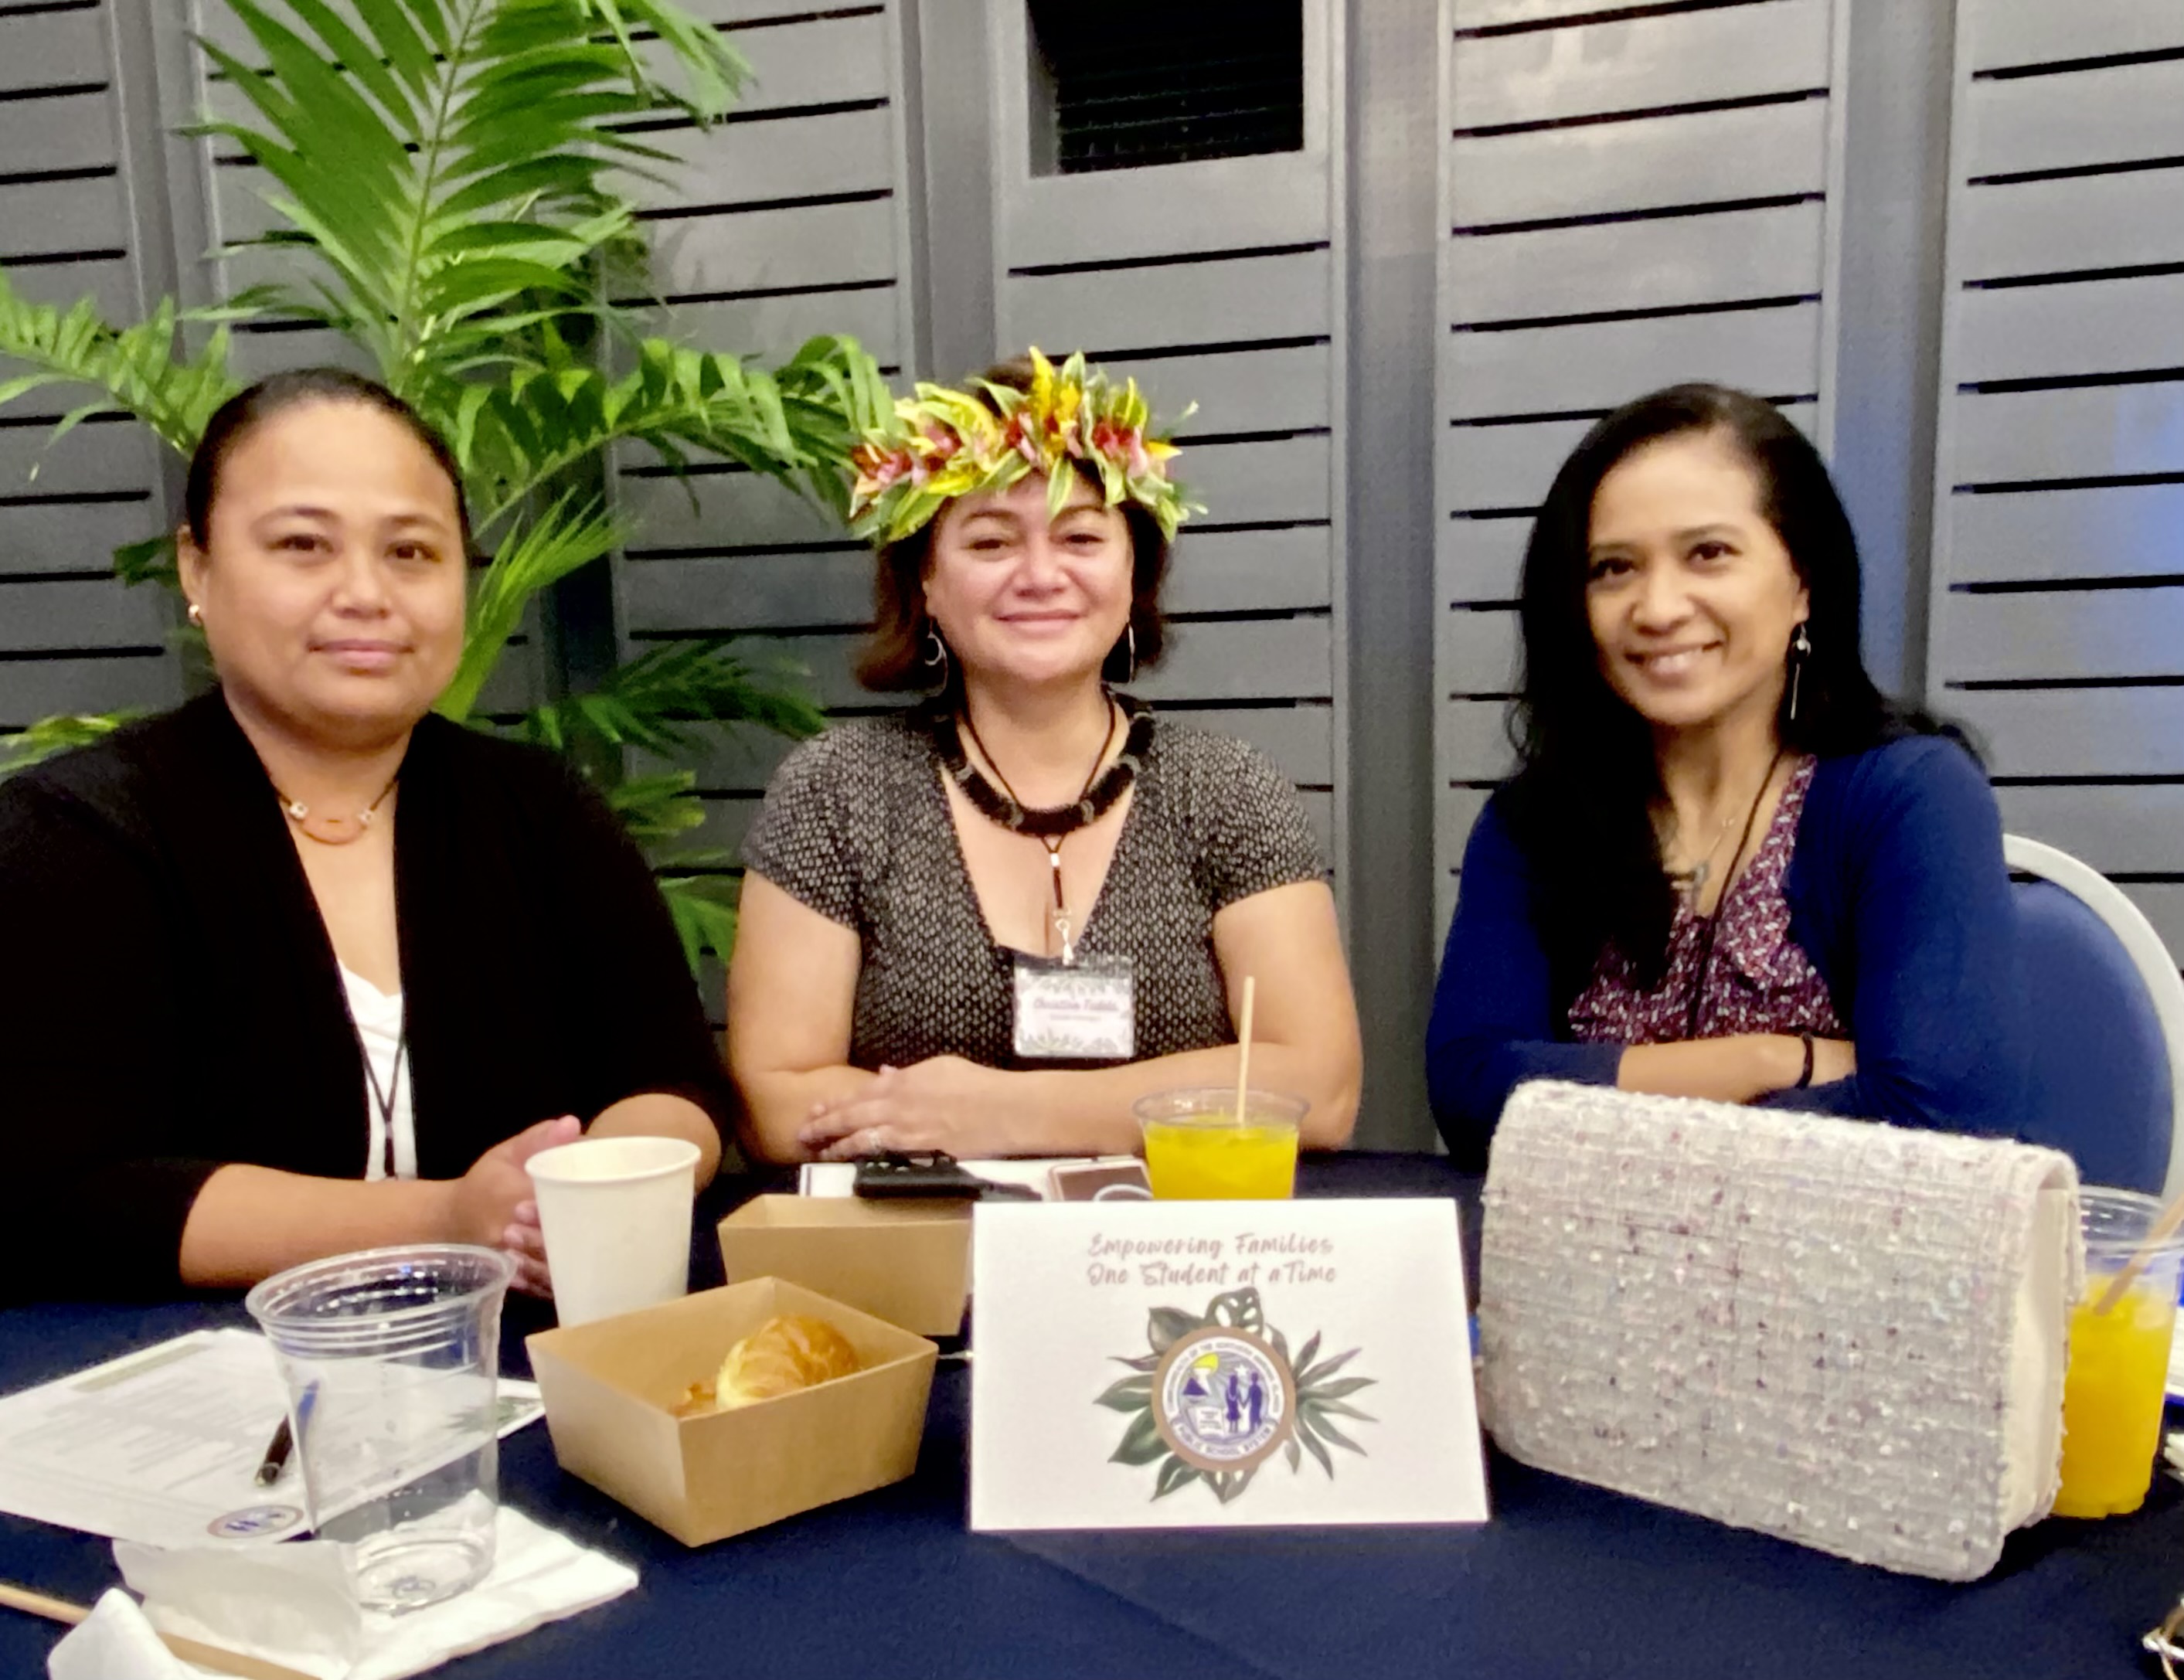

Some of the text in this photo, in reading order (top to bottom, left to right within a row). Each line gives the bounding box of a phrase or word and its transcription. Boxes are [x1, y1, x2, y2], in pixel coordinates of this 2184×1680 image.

[1087, 1232, 1334, 1260] Empowering Families
[1087, 1262, 1128, 1287] One
[1139, 1260, 1230, 1287] Student
[1237, 1261, 1260, 1285] at
